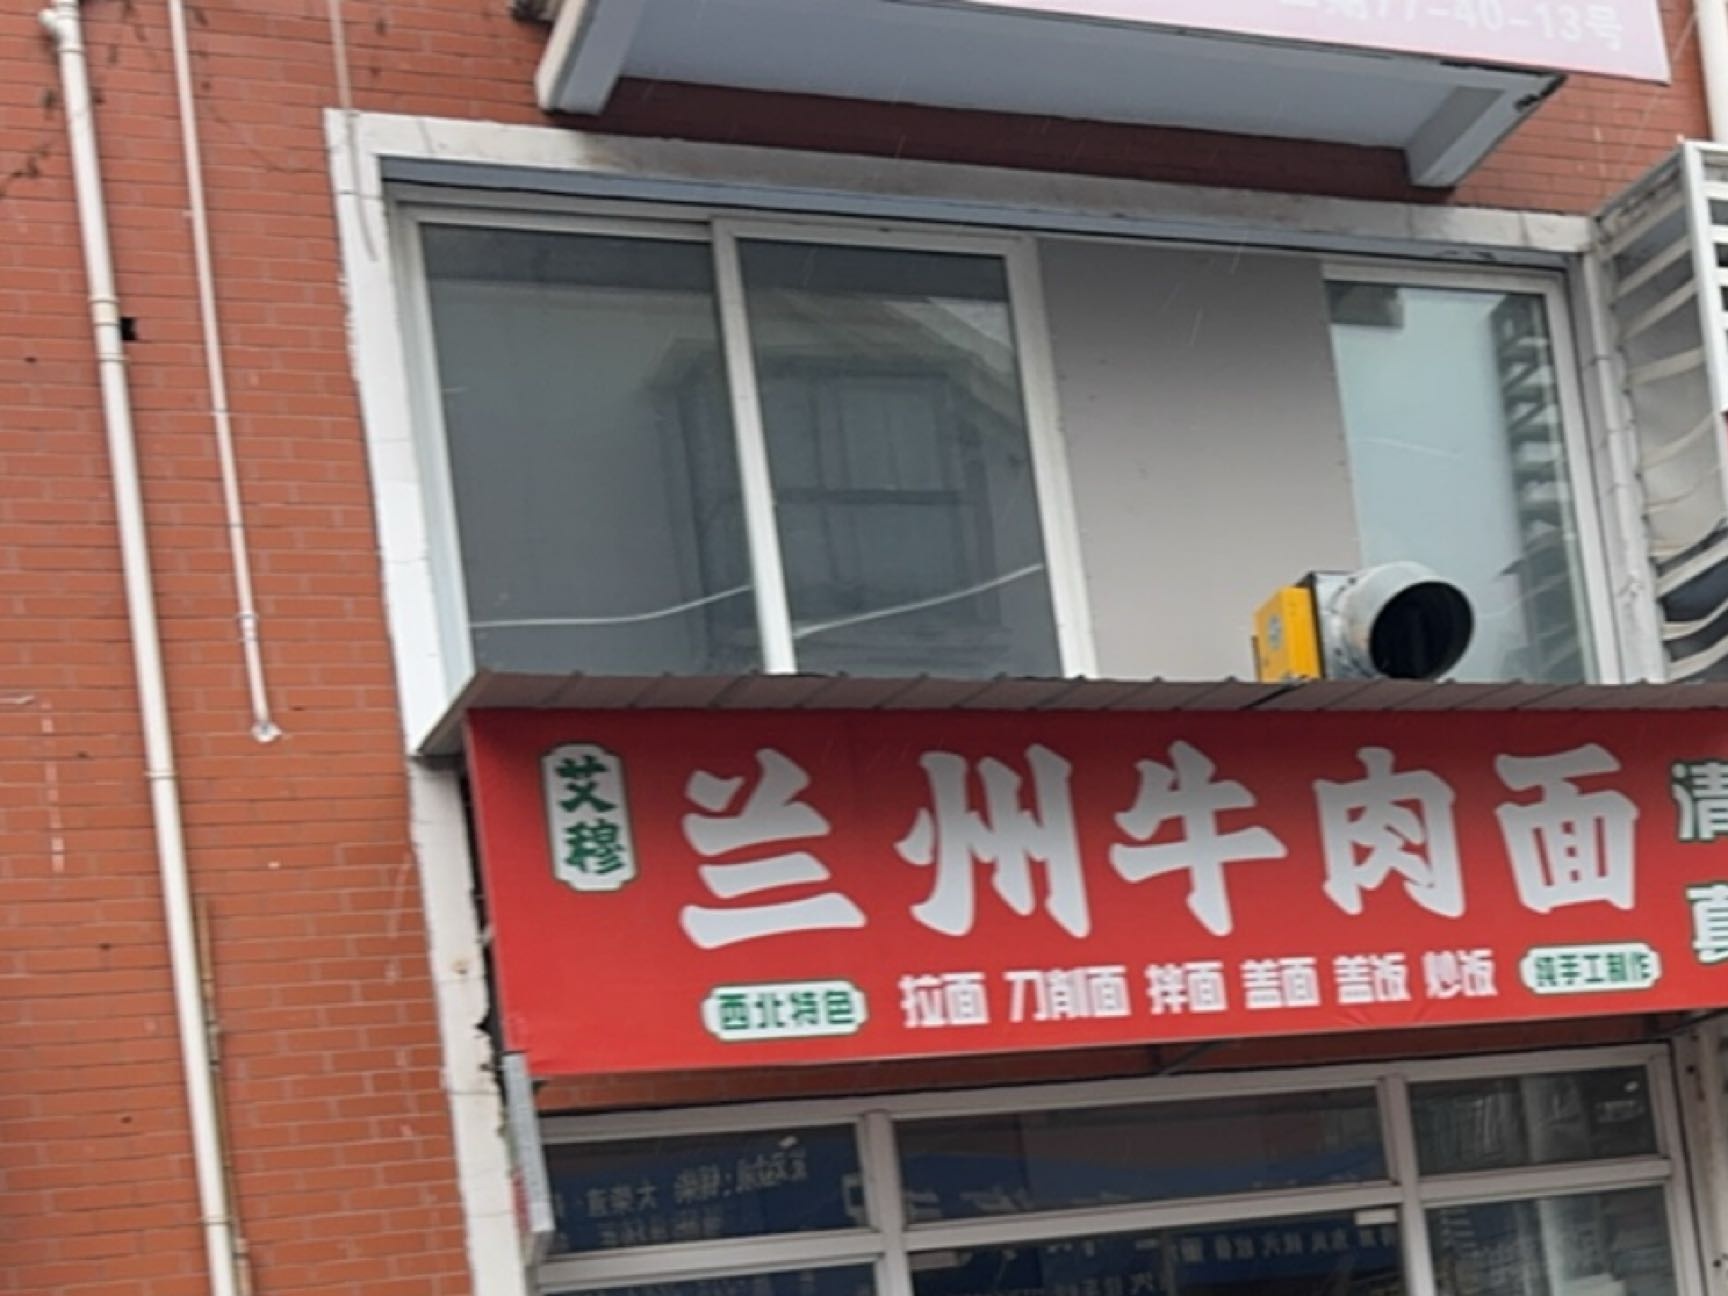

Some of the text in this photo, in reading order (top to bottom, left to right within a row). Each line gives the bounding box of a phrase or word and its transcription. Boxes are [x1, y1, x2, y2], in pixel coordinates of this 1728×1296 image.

[555, 755, 625, 874] 艾穆
[680, 740, 1639, 949] 兰州牛肉面
[718, 991, 856, 1030] 西北特色
[899, 949, 1498, 1028] 拉面 刀削面 拌面 盖面 盖饭 炒饭
